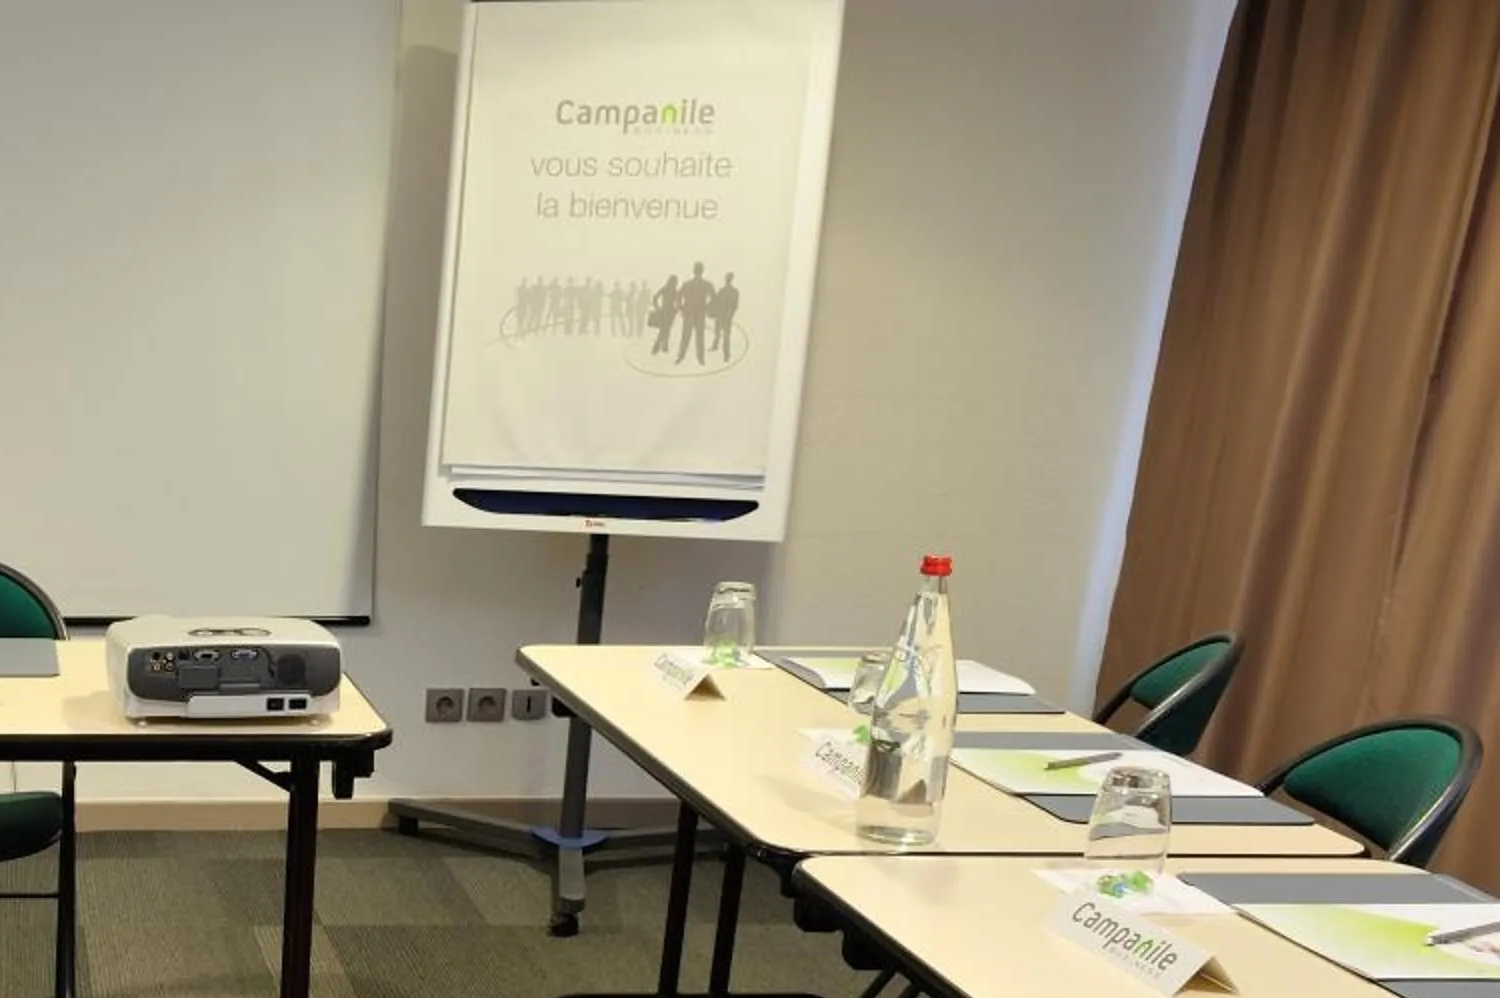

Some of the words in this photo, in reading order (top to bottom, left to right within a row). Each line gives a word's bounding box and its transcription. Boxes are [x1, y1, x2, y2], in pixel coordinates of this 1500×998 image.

[555, 97, 716, 134] Campanile
[530, 156, 598, 178] vous
[607, 151, 733, 179] souhaite
[536, 192, 559, 219] la
[568, 191, 719, 220] bienvenue
[1072, 902, 1177, 971] Campanile
